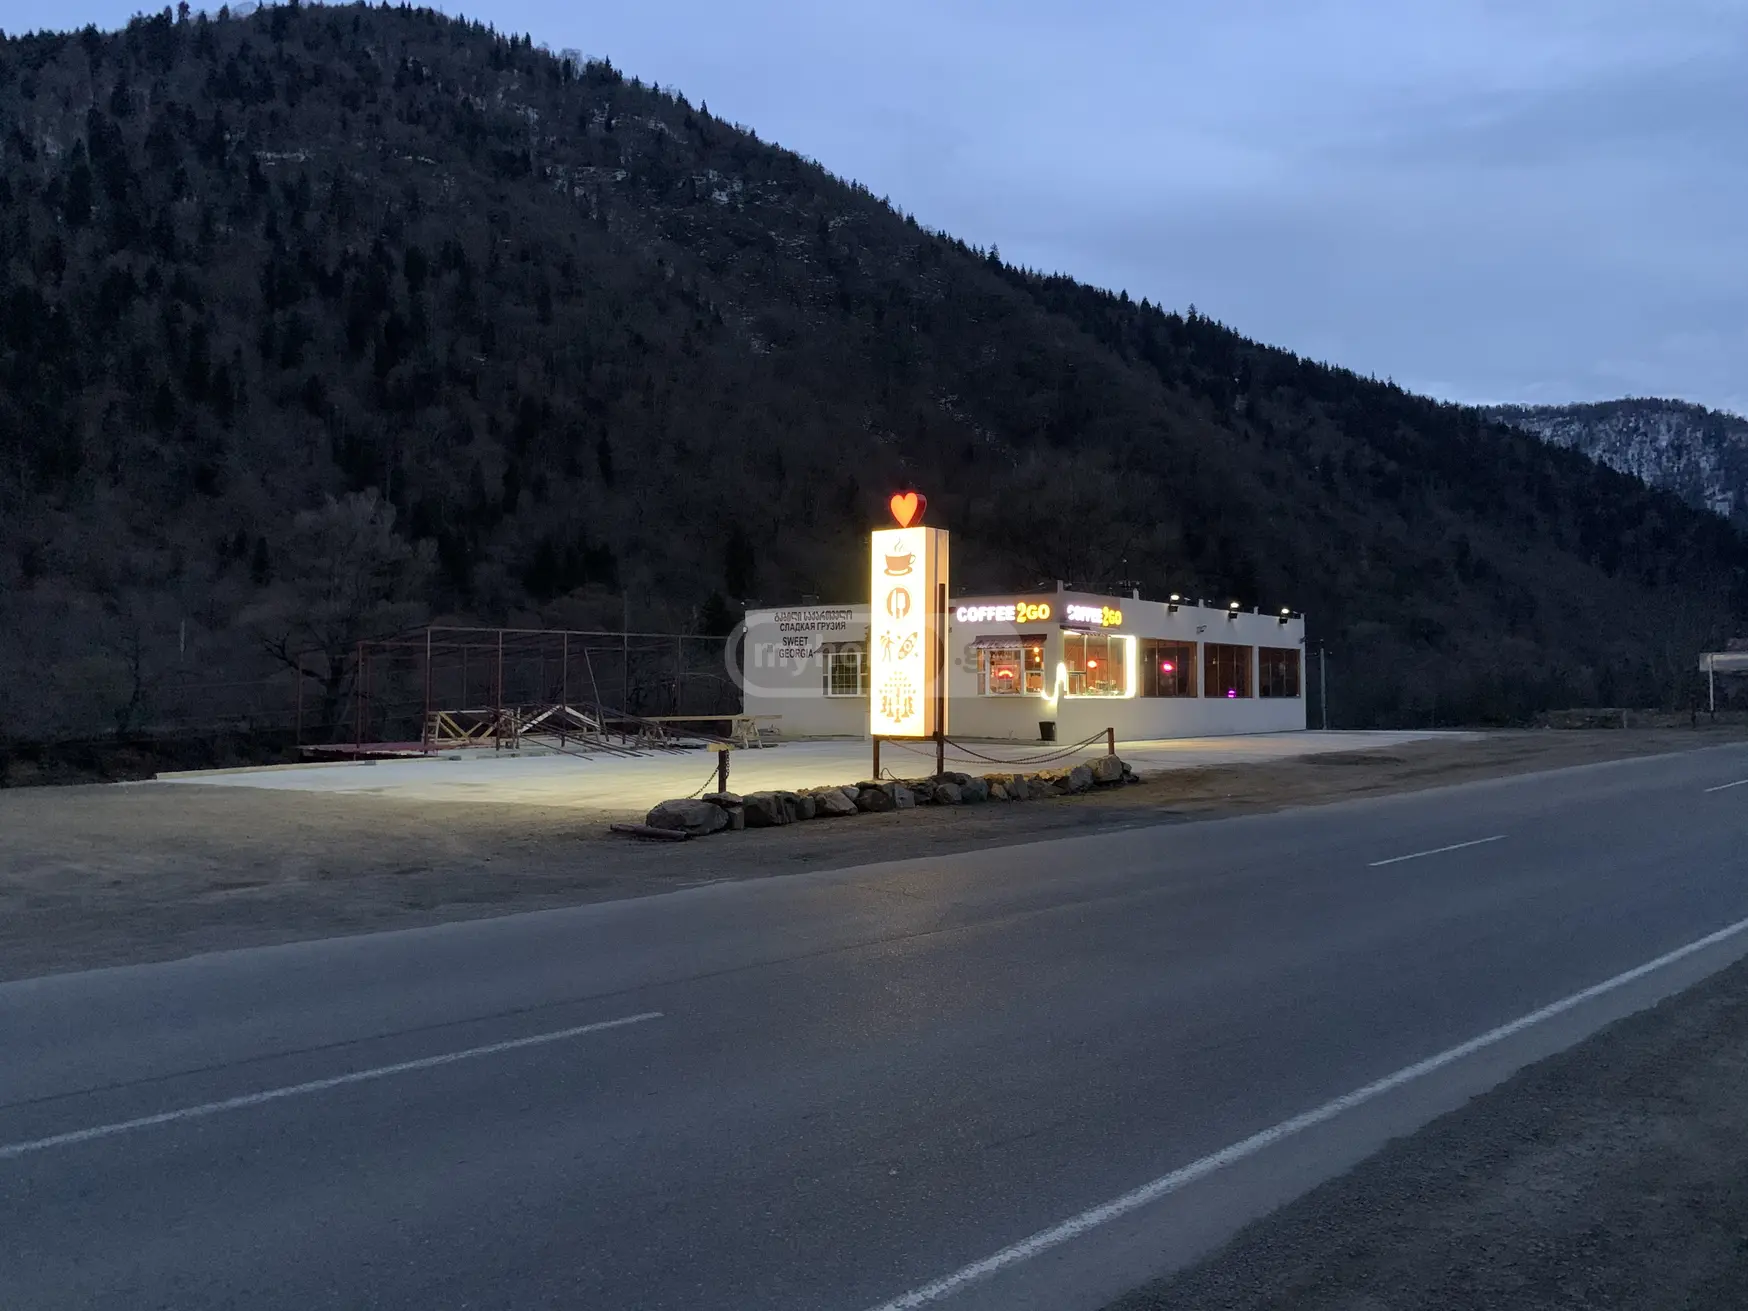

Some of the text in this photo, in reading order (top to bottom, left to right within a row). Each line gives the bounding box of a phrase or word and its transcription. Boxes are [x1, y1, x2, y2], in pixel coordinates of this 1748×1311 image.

[957, 602, 1050, 623] COFFEE 2GO
[779, 621, 846, 633] СЛАДКАЯ ГРУЗИЯ
[782, 636, 809, 647] SWEET
[779, 648, 814, 658] GEORGIA
